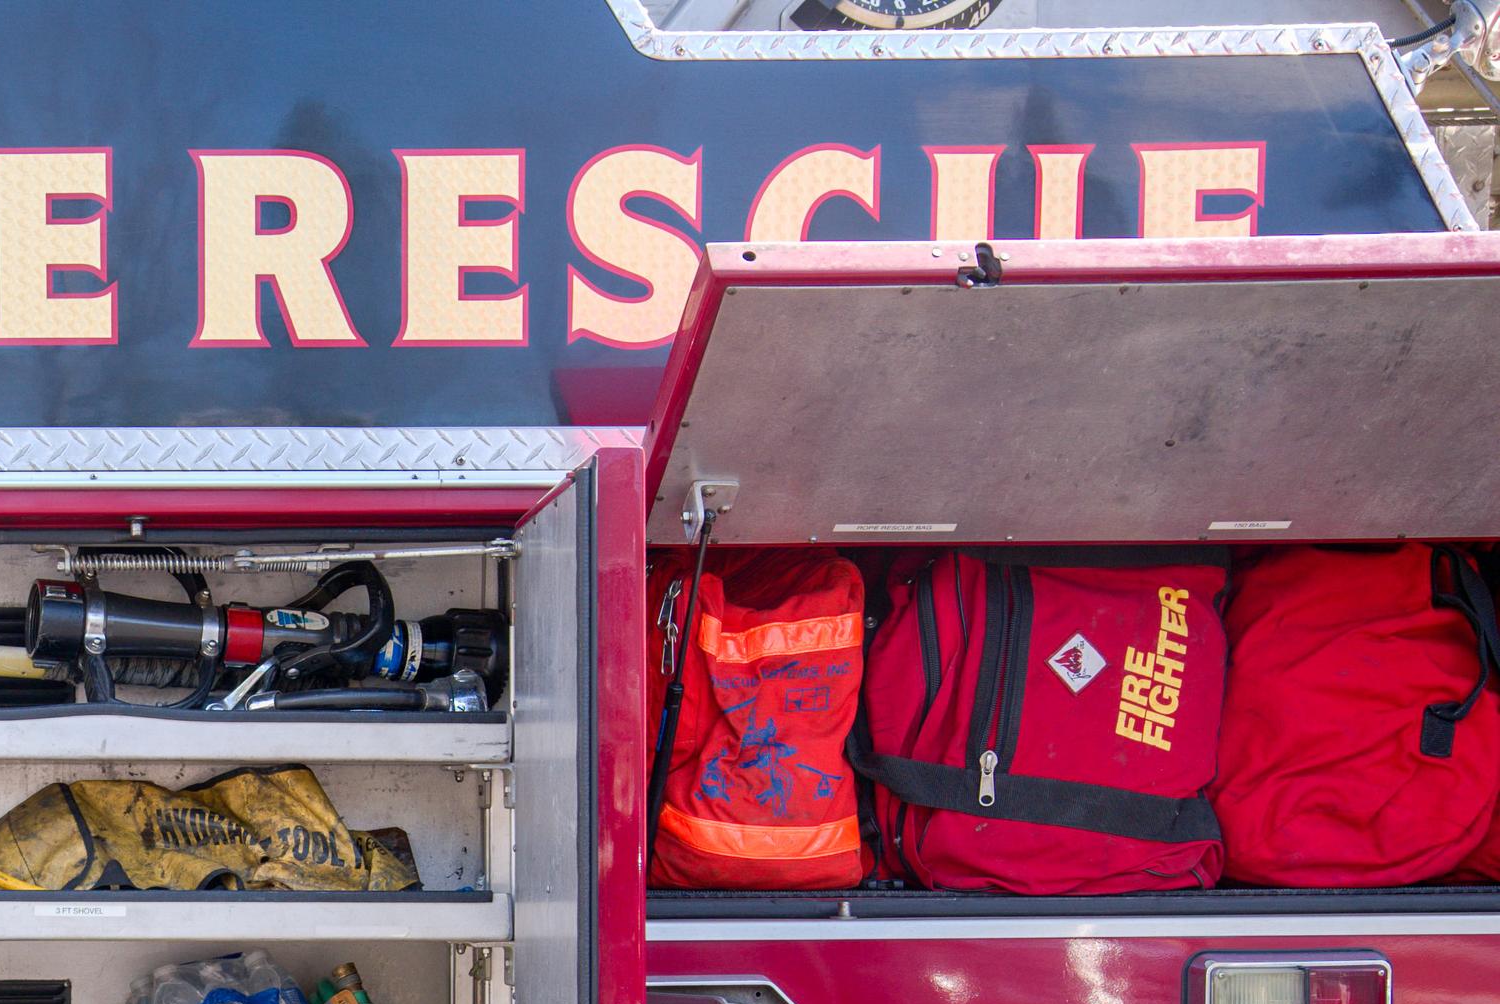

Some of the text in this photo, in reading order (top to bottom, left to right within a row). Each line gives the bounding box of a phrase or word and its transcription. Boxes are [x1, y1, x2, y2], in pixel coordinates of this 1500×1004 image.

[1115, 646, 1156, 743] FIRE
[1142, 586, 1189, 752] FIGHTER
[55, 907, 103, 916] 3 FT SHOVEL
